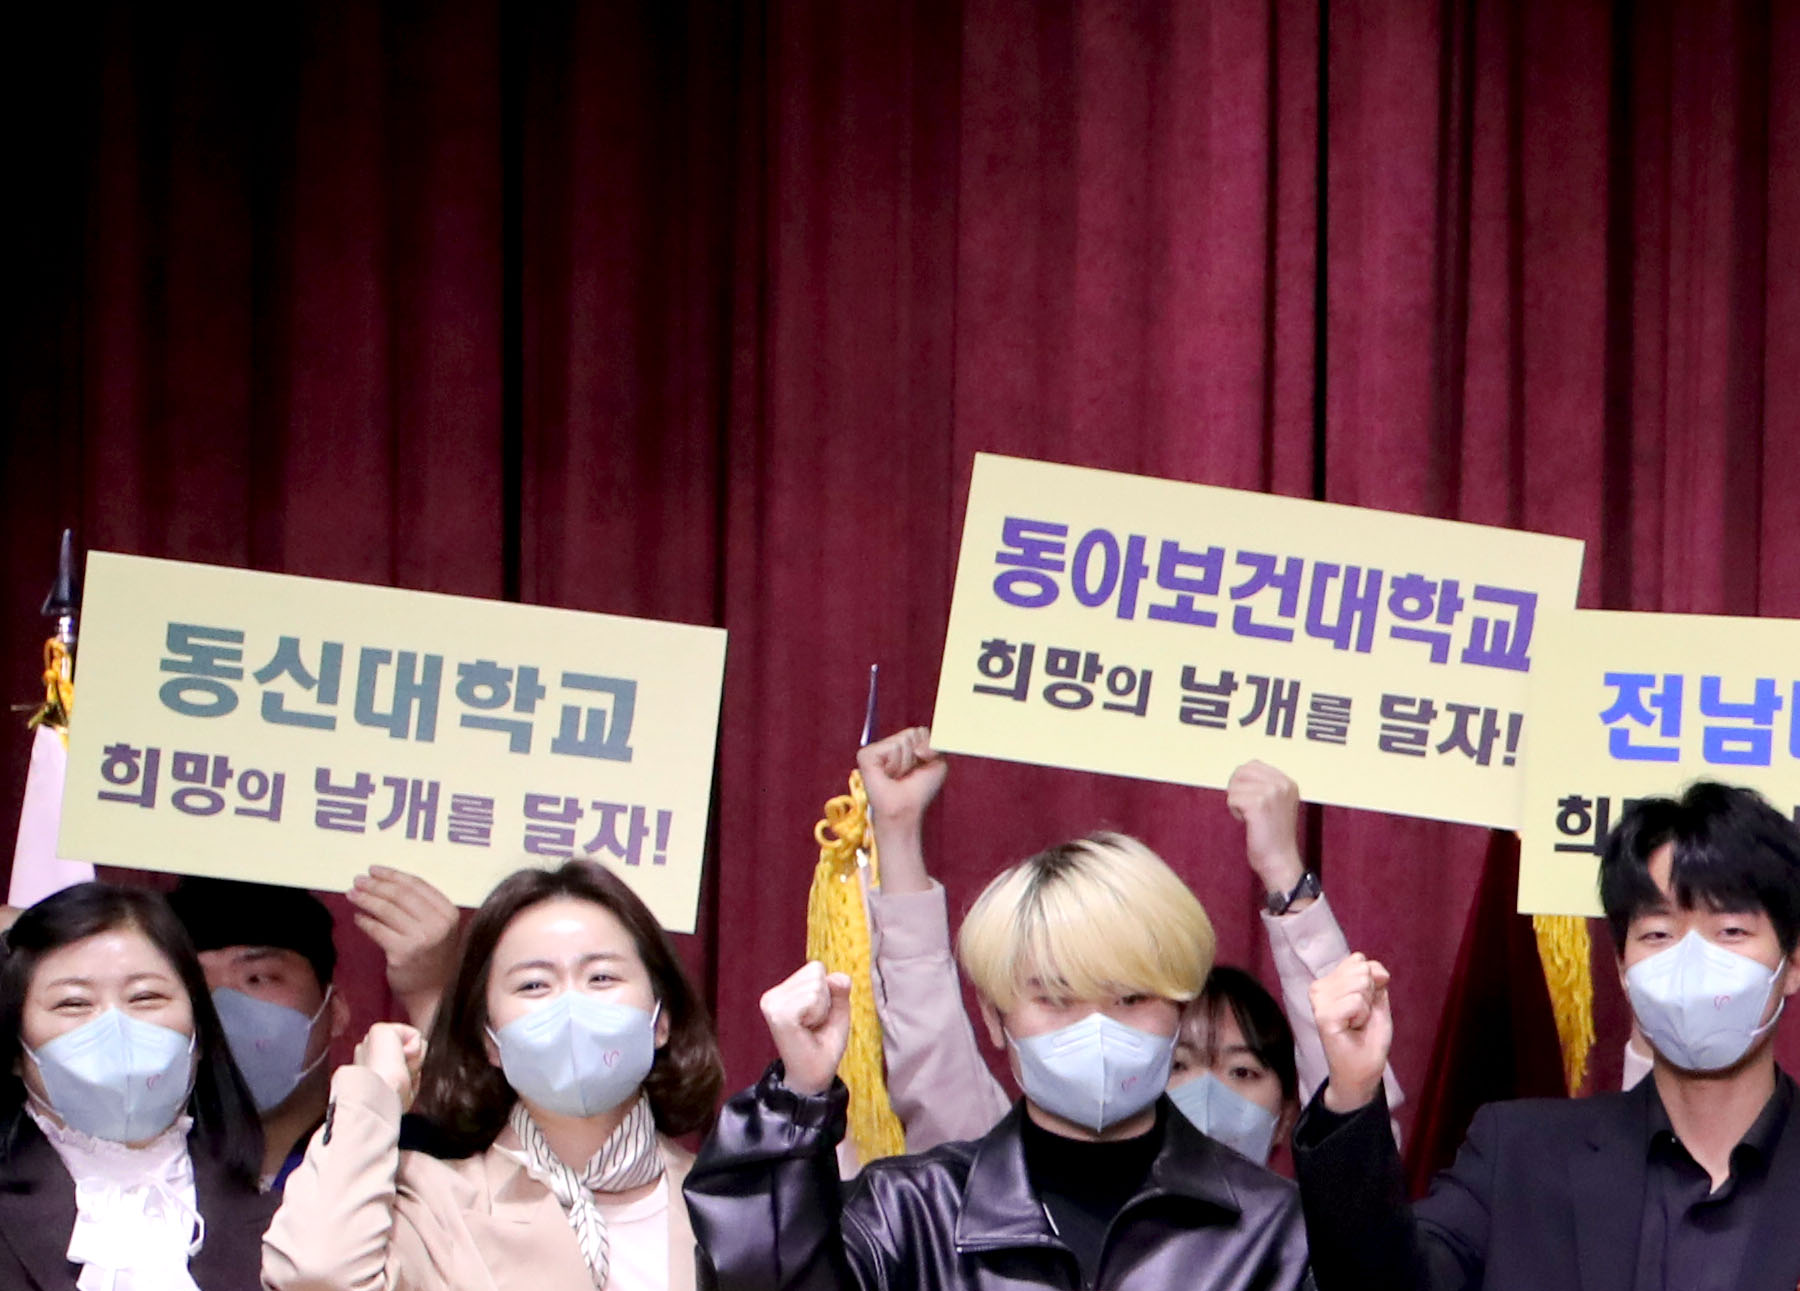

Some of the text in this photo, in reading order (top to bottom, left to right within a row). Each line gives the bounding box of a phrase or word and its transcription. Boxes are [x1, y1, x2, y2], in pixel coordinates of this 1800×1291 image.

[991, 516, 1539, 672] 동아보건대학교
[158, 621, 638, 763] 동신대학교
[973, 637, 1522, 768] 희망의 날개를 달자!
[97, 742, 672, 866] 희망의 날개를 달자!
